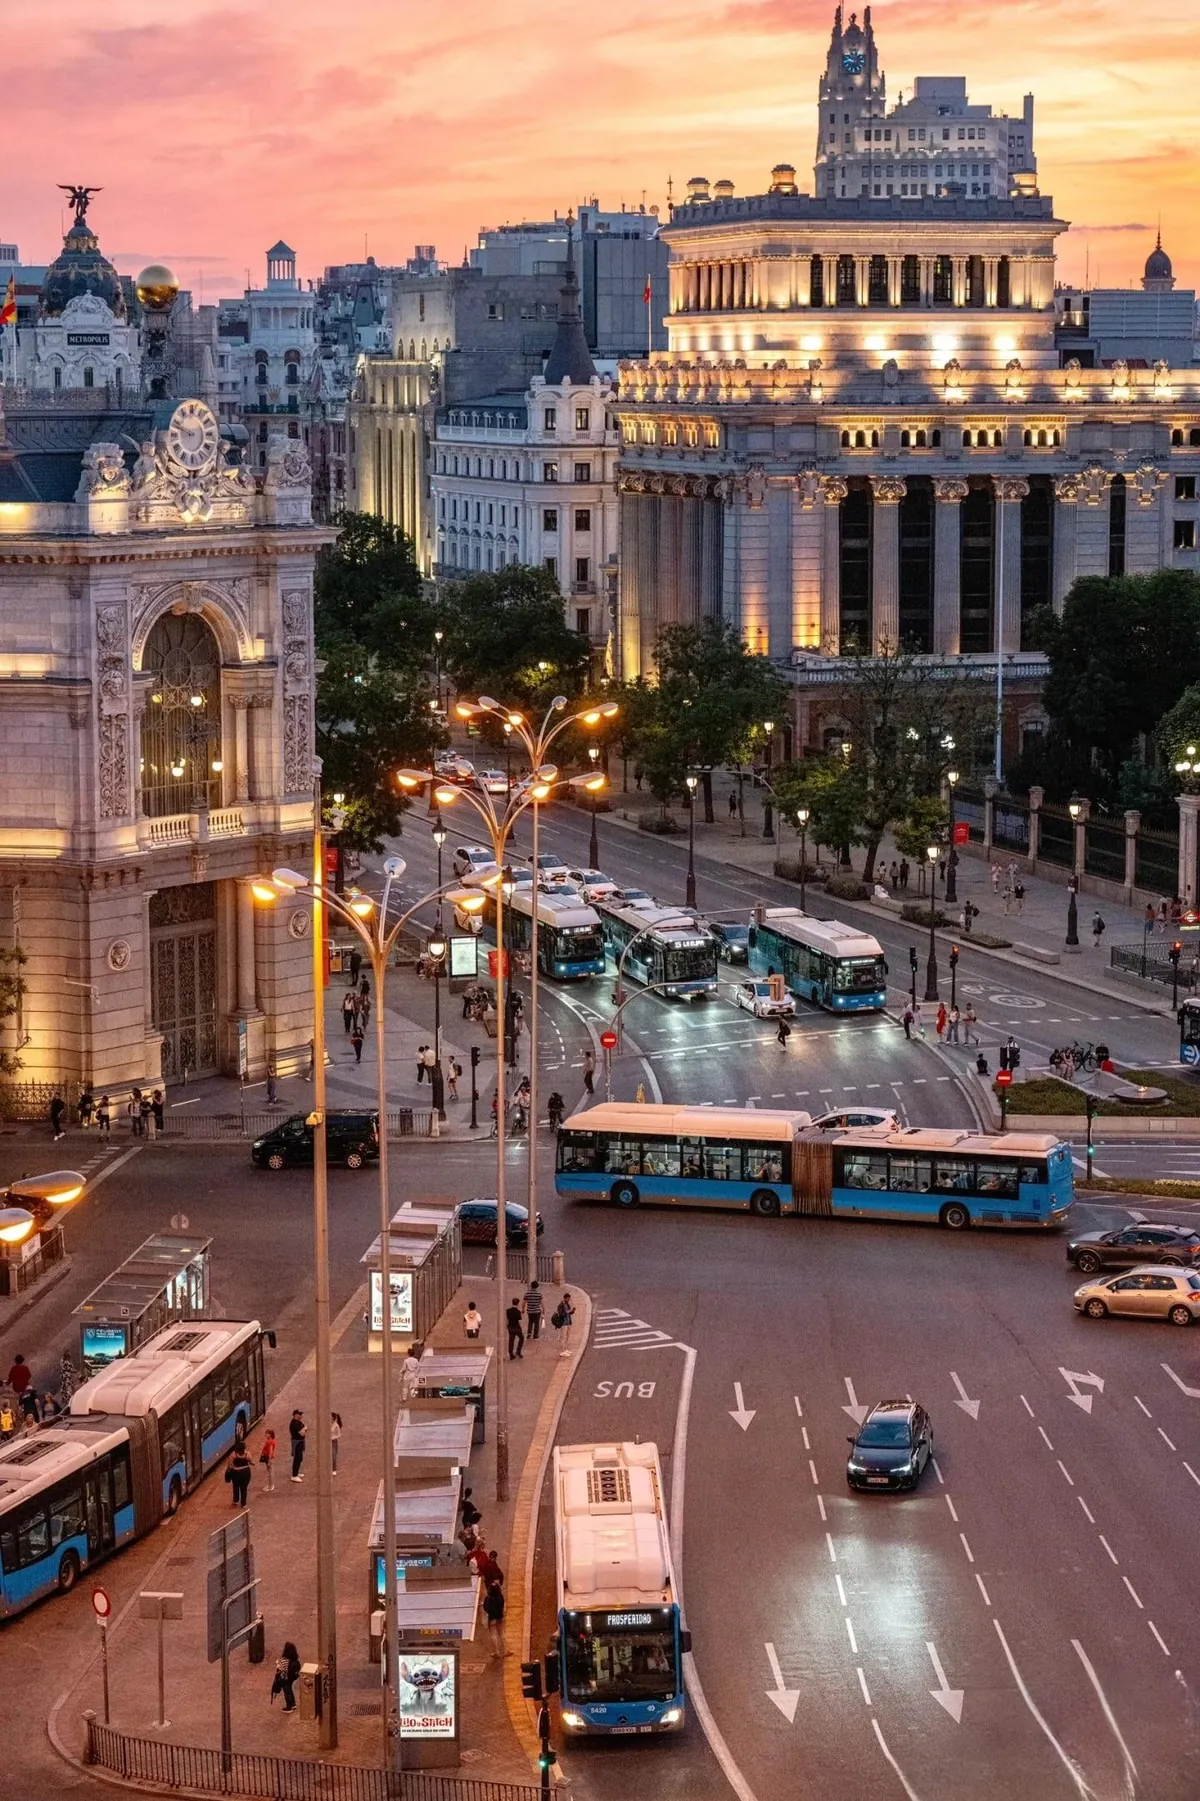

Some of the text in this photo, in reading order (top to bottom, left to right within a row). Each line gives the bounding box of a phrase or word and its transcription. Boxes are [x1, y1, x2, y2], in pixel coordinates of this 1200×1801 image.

[593, 1381, 656, 1398] BUS
[586, 1613, 651, 1627] 1 PROSPERIDAD
